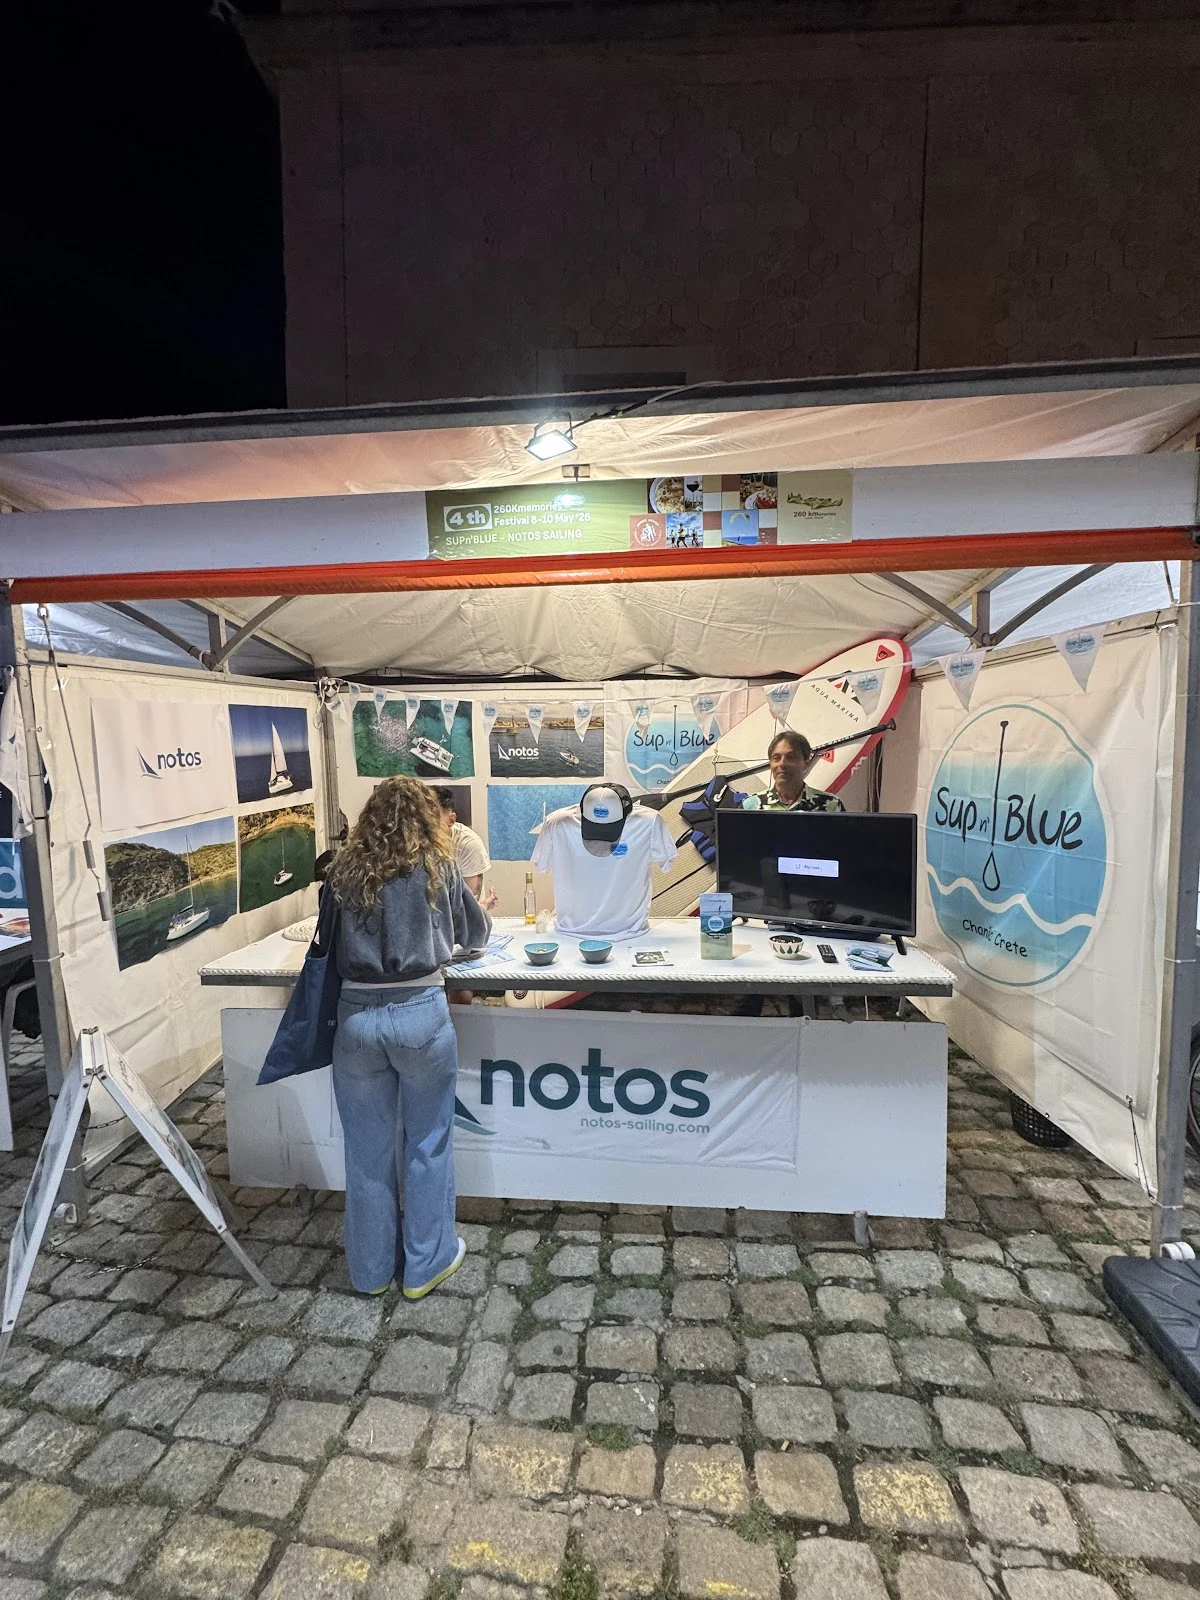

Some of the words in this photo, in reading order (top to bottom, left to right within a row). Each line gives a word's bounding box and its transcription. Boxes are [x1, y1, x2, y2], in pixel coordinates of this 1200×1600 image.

[449, 512, 464, 526] 4
[466, 510, 486, 525] th
[494, 515, 529, 526] Festival
[530, 514, 553, 525] 8-10
[554, 513, 574, 525] May
[445, 534, 498, 546] SUPn'BLUE
[507, 530, 541, 542] NOTOS
[543, 529, 583, 540] SAILING
[810, 684, 829, 700] AQUA
[830, 699, 859, 723] MARINA
[633, 730, 664, 751] Sup
[680, 730, 716, 748] Blue
[157, 748, 202, 770] notos
[508, 746, 539, 757] notos
[935, 786, 977, 843] Sup
[1004, 794, 1083, 850] Blue
[994, 933, 1028, 958] Crete
[480, 1047, 711, 1119] notos
[580, 1116, 711, 1135] notos-sailing.com
